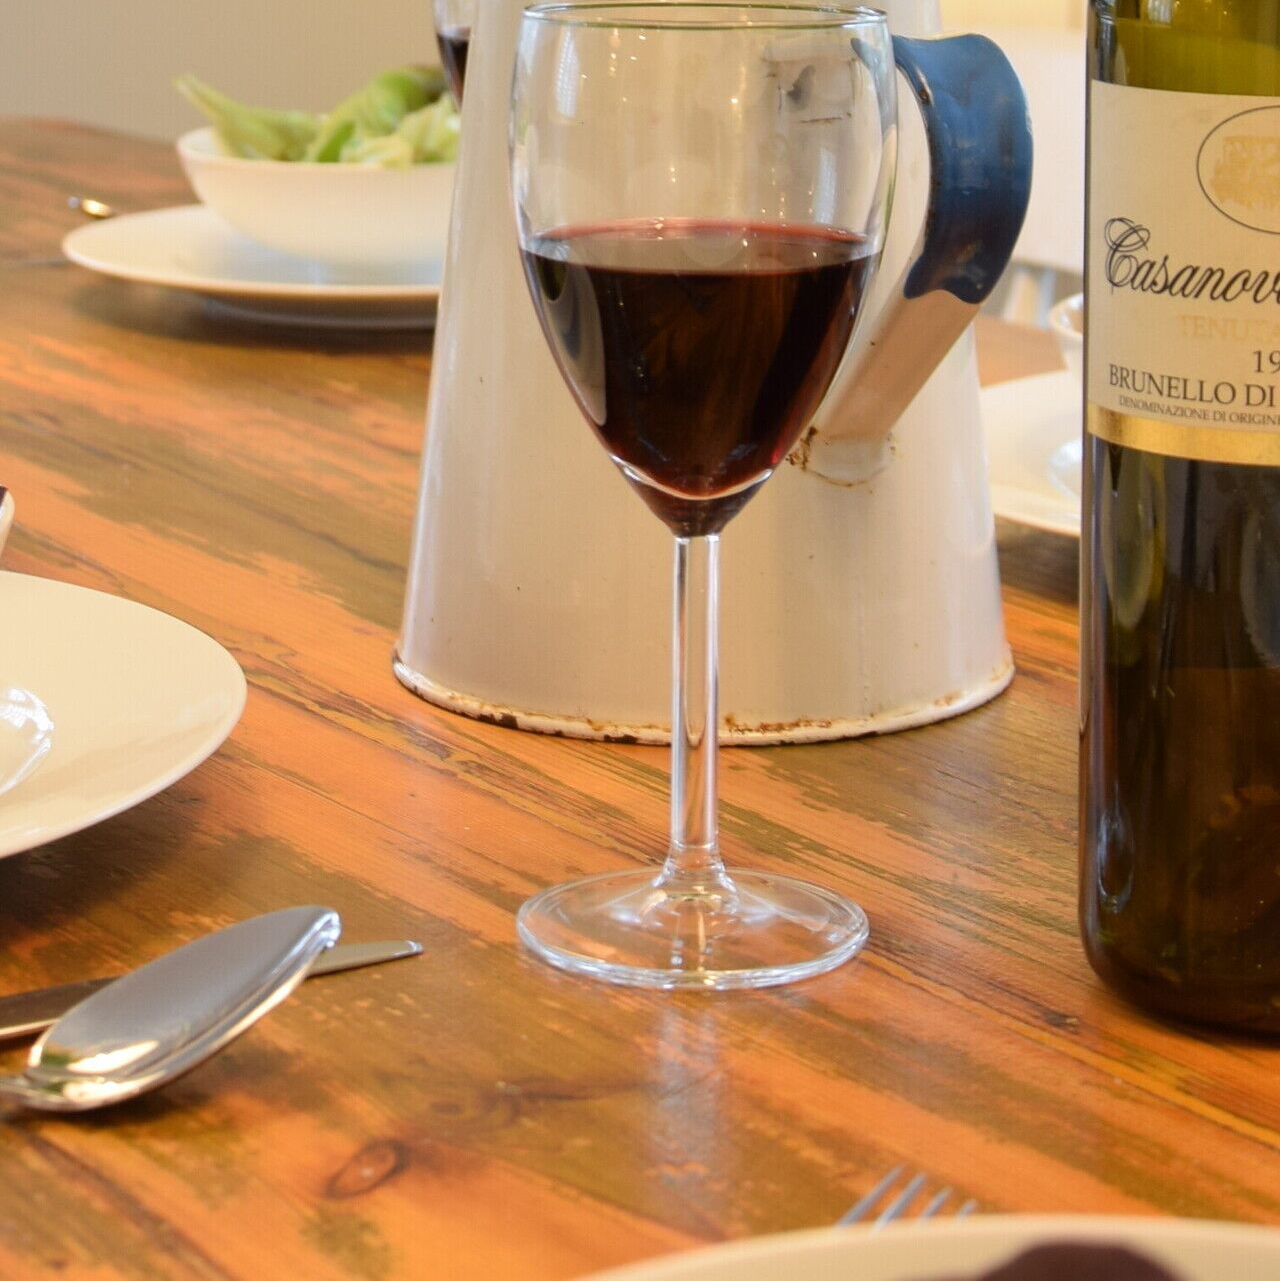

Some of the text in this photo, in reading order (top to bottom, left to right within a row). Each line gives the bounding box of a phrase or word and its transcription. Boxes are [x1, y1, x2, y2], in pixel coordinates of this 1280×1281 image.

[1109, 362, 1237, 405] BRUNELLO
[1245, 383, 1276, 408] DI
[1119, 394, 1211, 420] DENOMINAZIONE
[1213, 409, 1226, 421] DI
